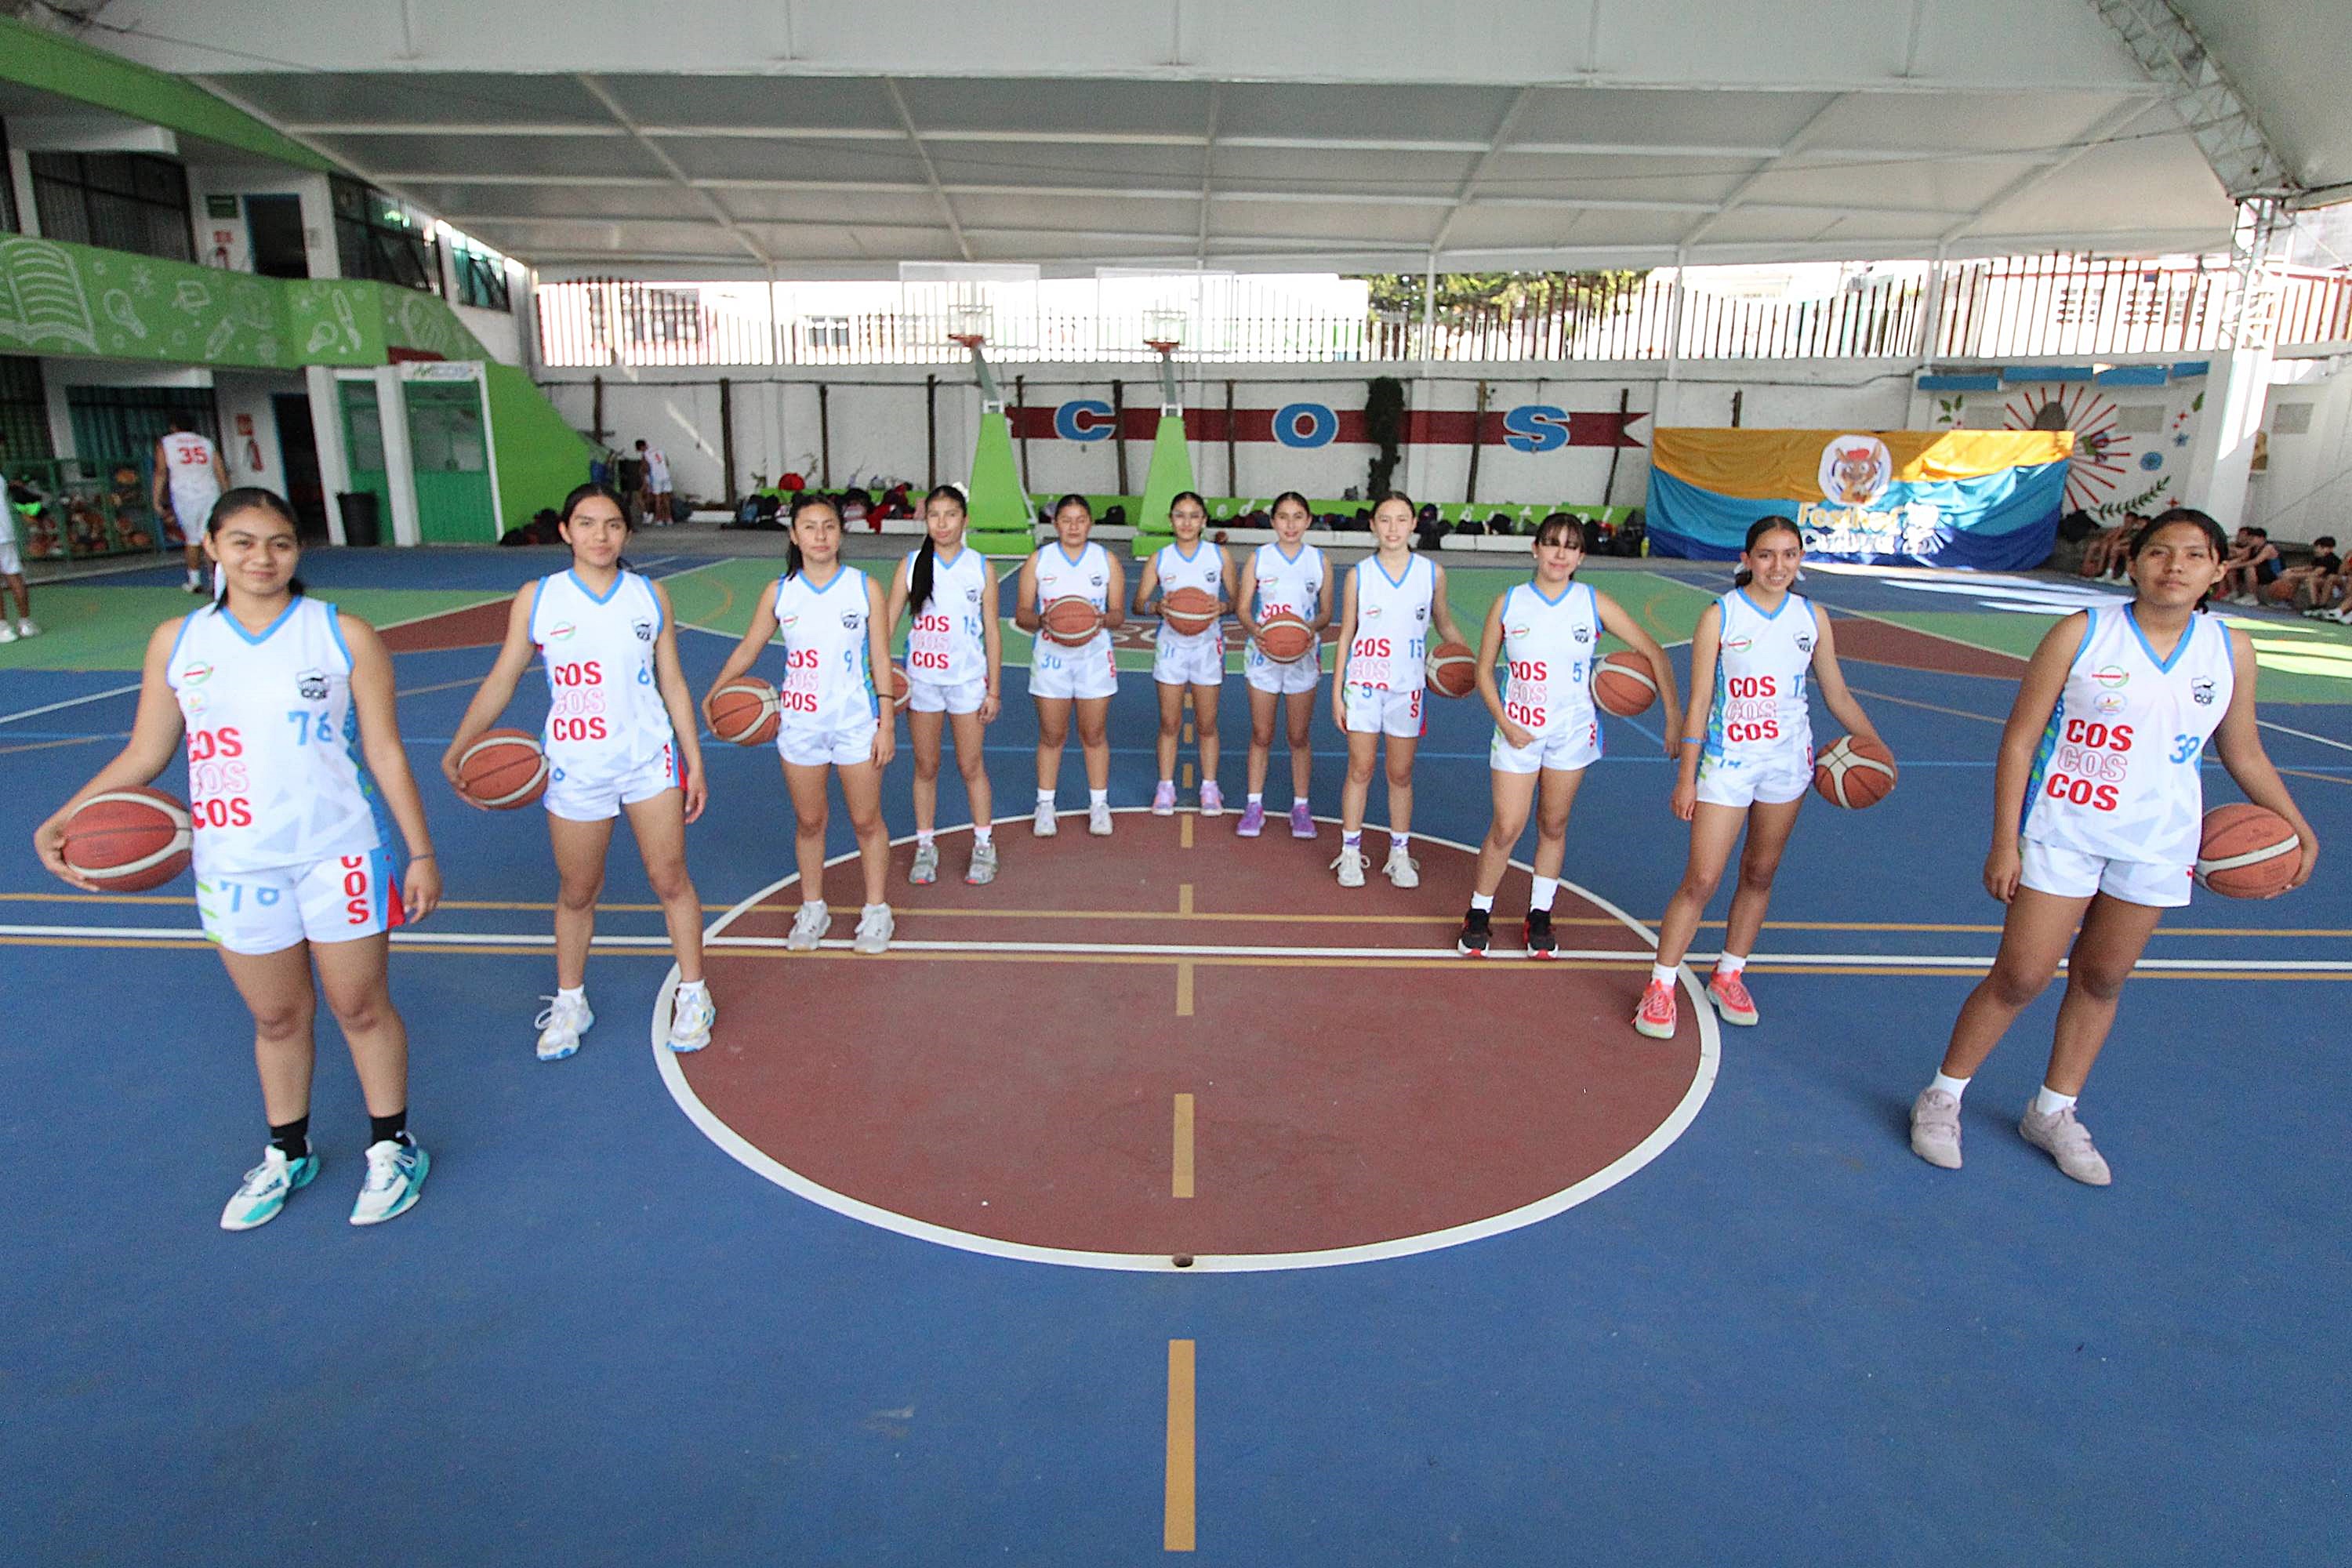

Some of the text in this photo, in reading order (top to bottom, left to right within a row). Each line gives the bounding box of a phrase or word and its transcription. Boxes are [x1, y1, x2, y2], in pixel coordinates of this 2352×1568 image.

[179, 446, 209, 465] 35
[1353, 638, 1391, 658] COS
[844, 650, 852, 672] 9
[912, 651, 949, 670] COS
[1509, 661, 1548, 681] COS
[1573, 661, 1583, 683] 5
[1729, 676, 1777, 699] COS
[781, 691, 818, 713] COS
[1507, 702, 1546, 728] COS
[288, 711, 332, 746] 76
[553, 717, 607, 741] COS
[1727, 720, 1779, 742] COS
[2066, 719, 2134, 752] COS
[2057, 744, 2128, 782] COS
[2046, 773, 2119, 811] COS
